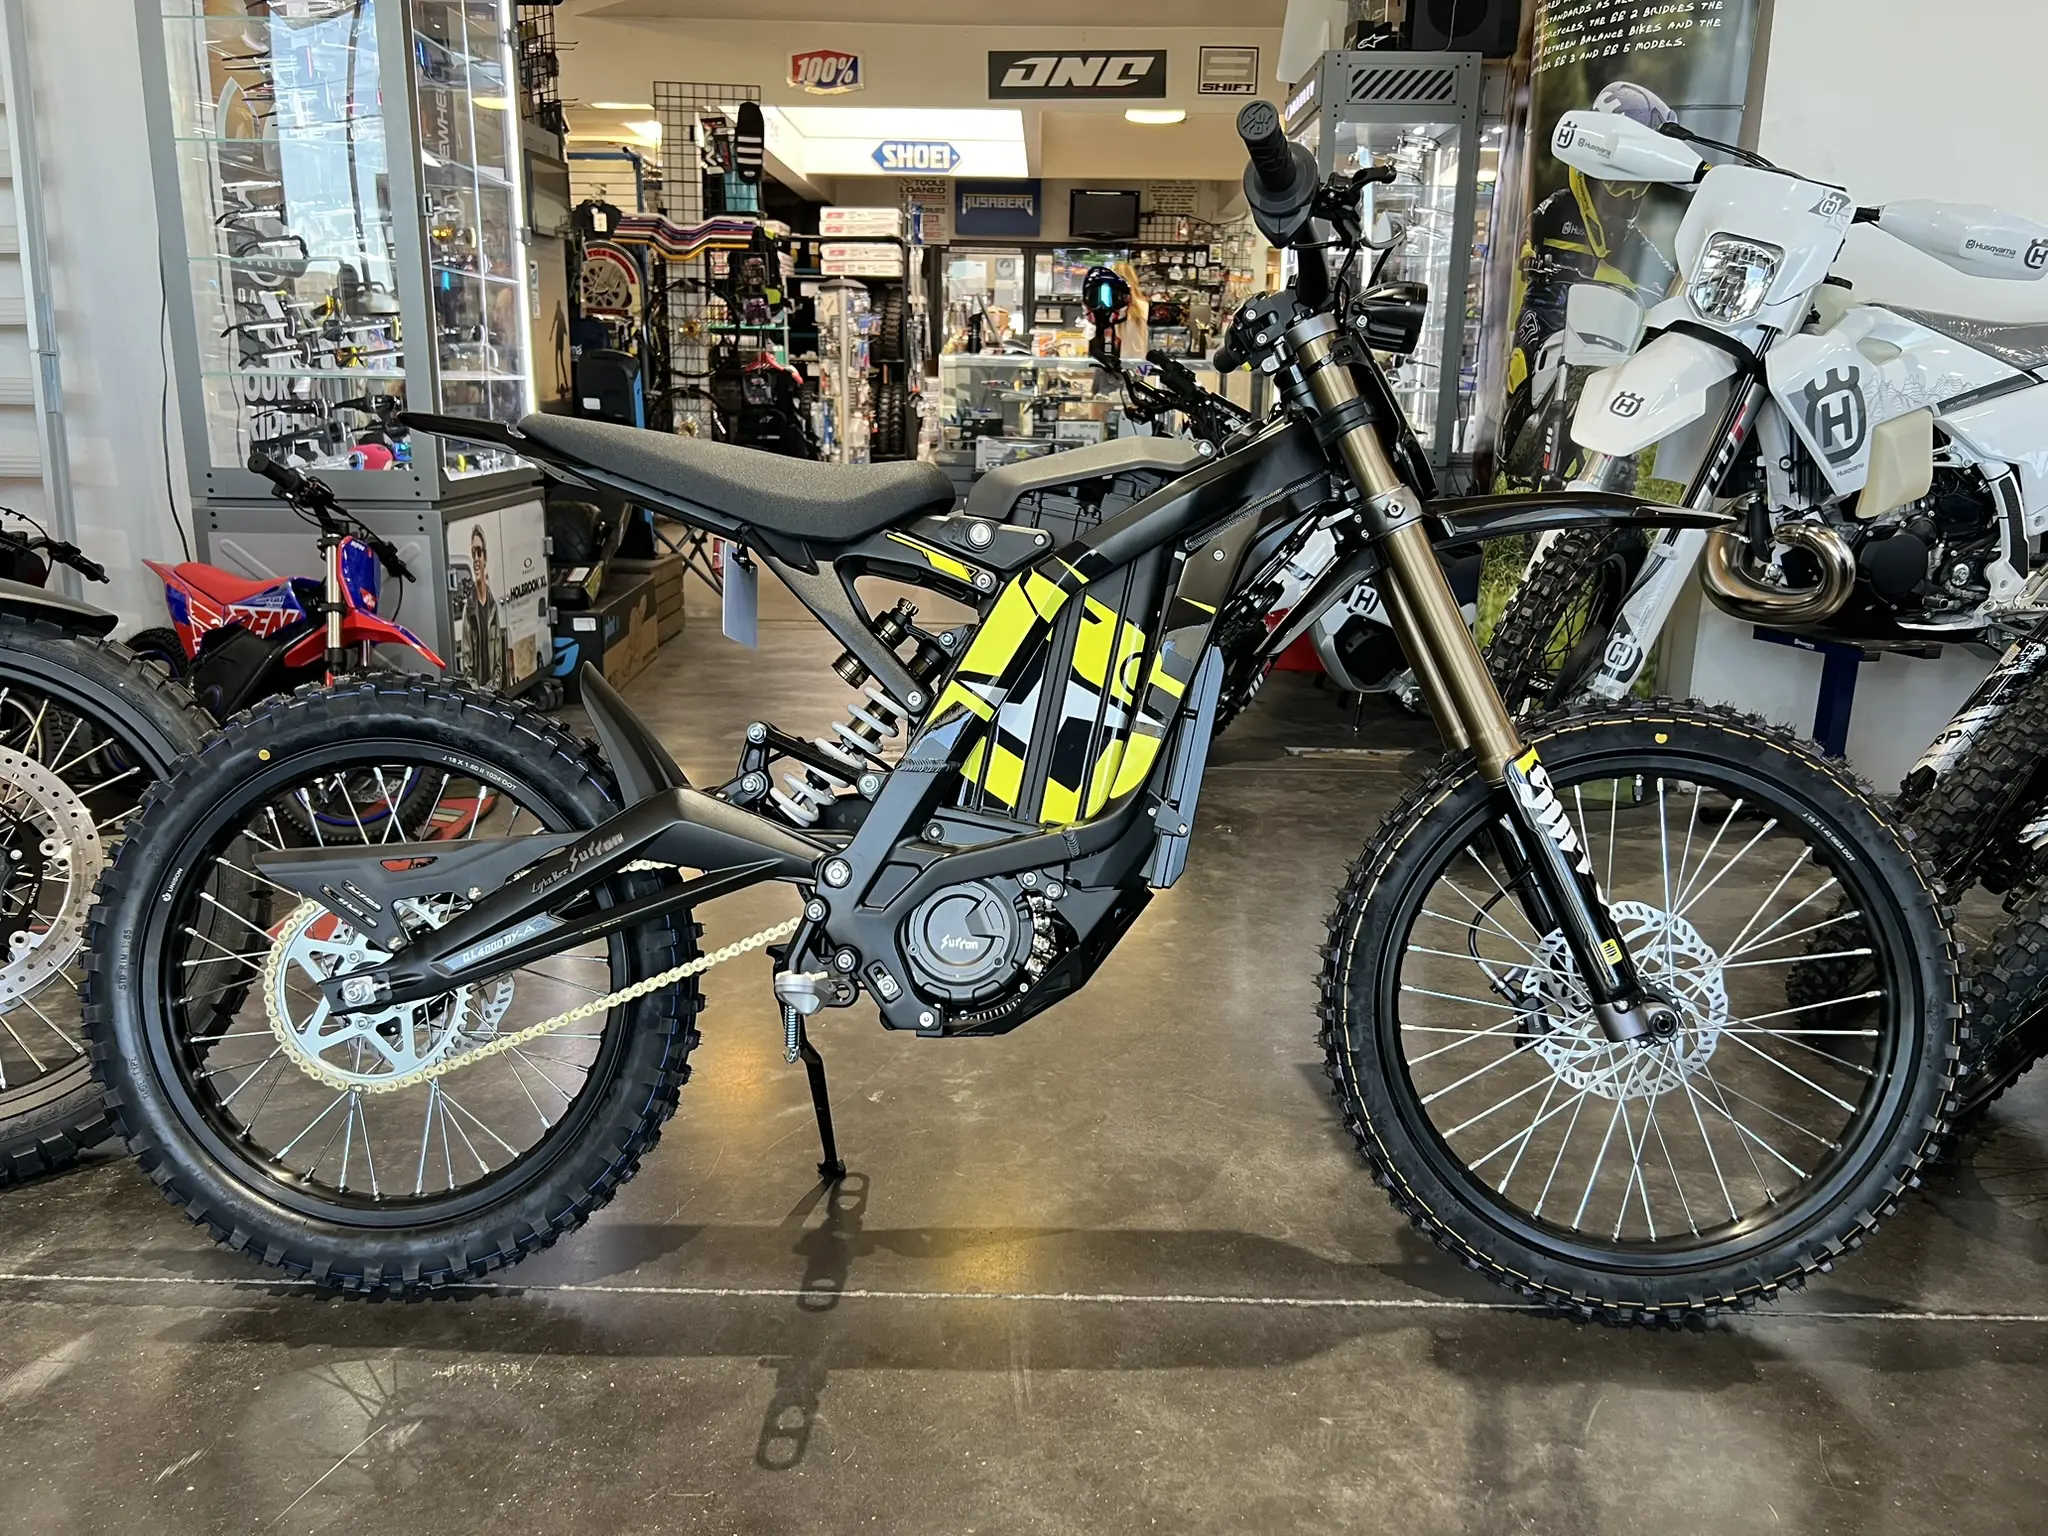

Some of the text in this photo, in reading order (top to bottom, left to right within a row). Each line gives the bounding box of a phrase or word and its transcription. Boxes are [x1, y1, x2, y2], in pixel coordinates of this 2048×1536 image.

[1544, 3, 1592, 27] STANDARDS
[1589, 16, 1606, 27] THE
[1630, 9, 1638, 20] 2
[1643, 2, 1695, 18] BRIDGES
[1701, 1, 1724, 10] THE
[1543, 40, 1577, 57] BETWEEN
[1580, 29, 1624, 45] BALANCE
[1628, 23, 1662, 36] BIKES
[1668, 19, 1693, 30] AND
[1699, 18, 1722, 28] THE
[1569, 53, 1576, 64] 3
[1579, 48, 1600, 61] AND
[1635, 37, 1686, 52] MODELS.
[798, 56, 855, 87] 100%
[1201, 83, 1254, 92] SHIFT
[881, 144, 951, 169] SHOEI
[914, 179, 946, 187] TOOLS
[961, 193, 1034, 217] HUSABERG
[1975, 242, 2017, 256] Husqvarna
[501, 779, 517, 791] DOT
[1842, 848, 1856, 861] DOT
[168, 867, 183, 892] UNISON
[940, 933, 979, 950] Surron
